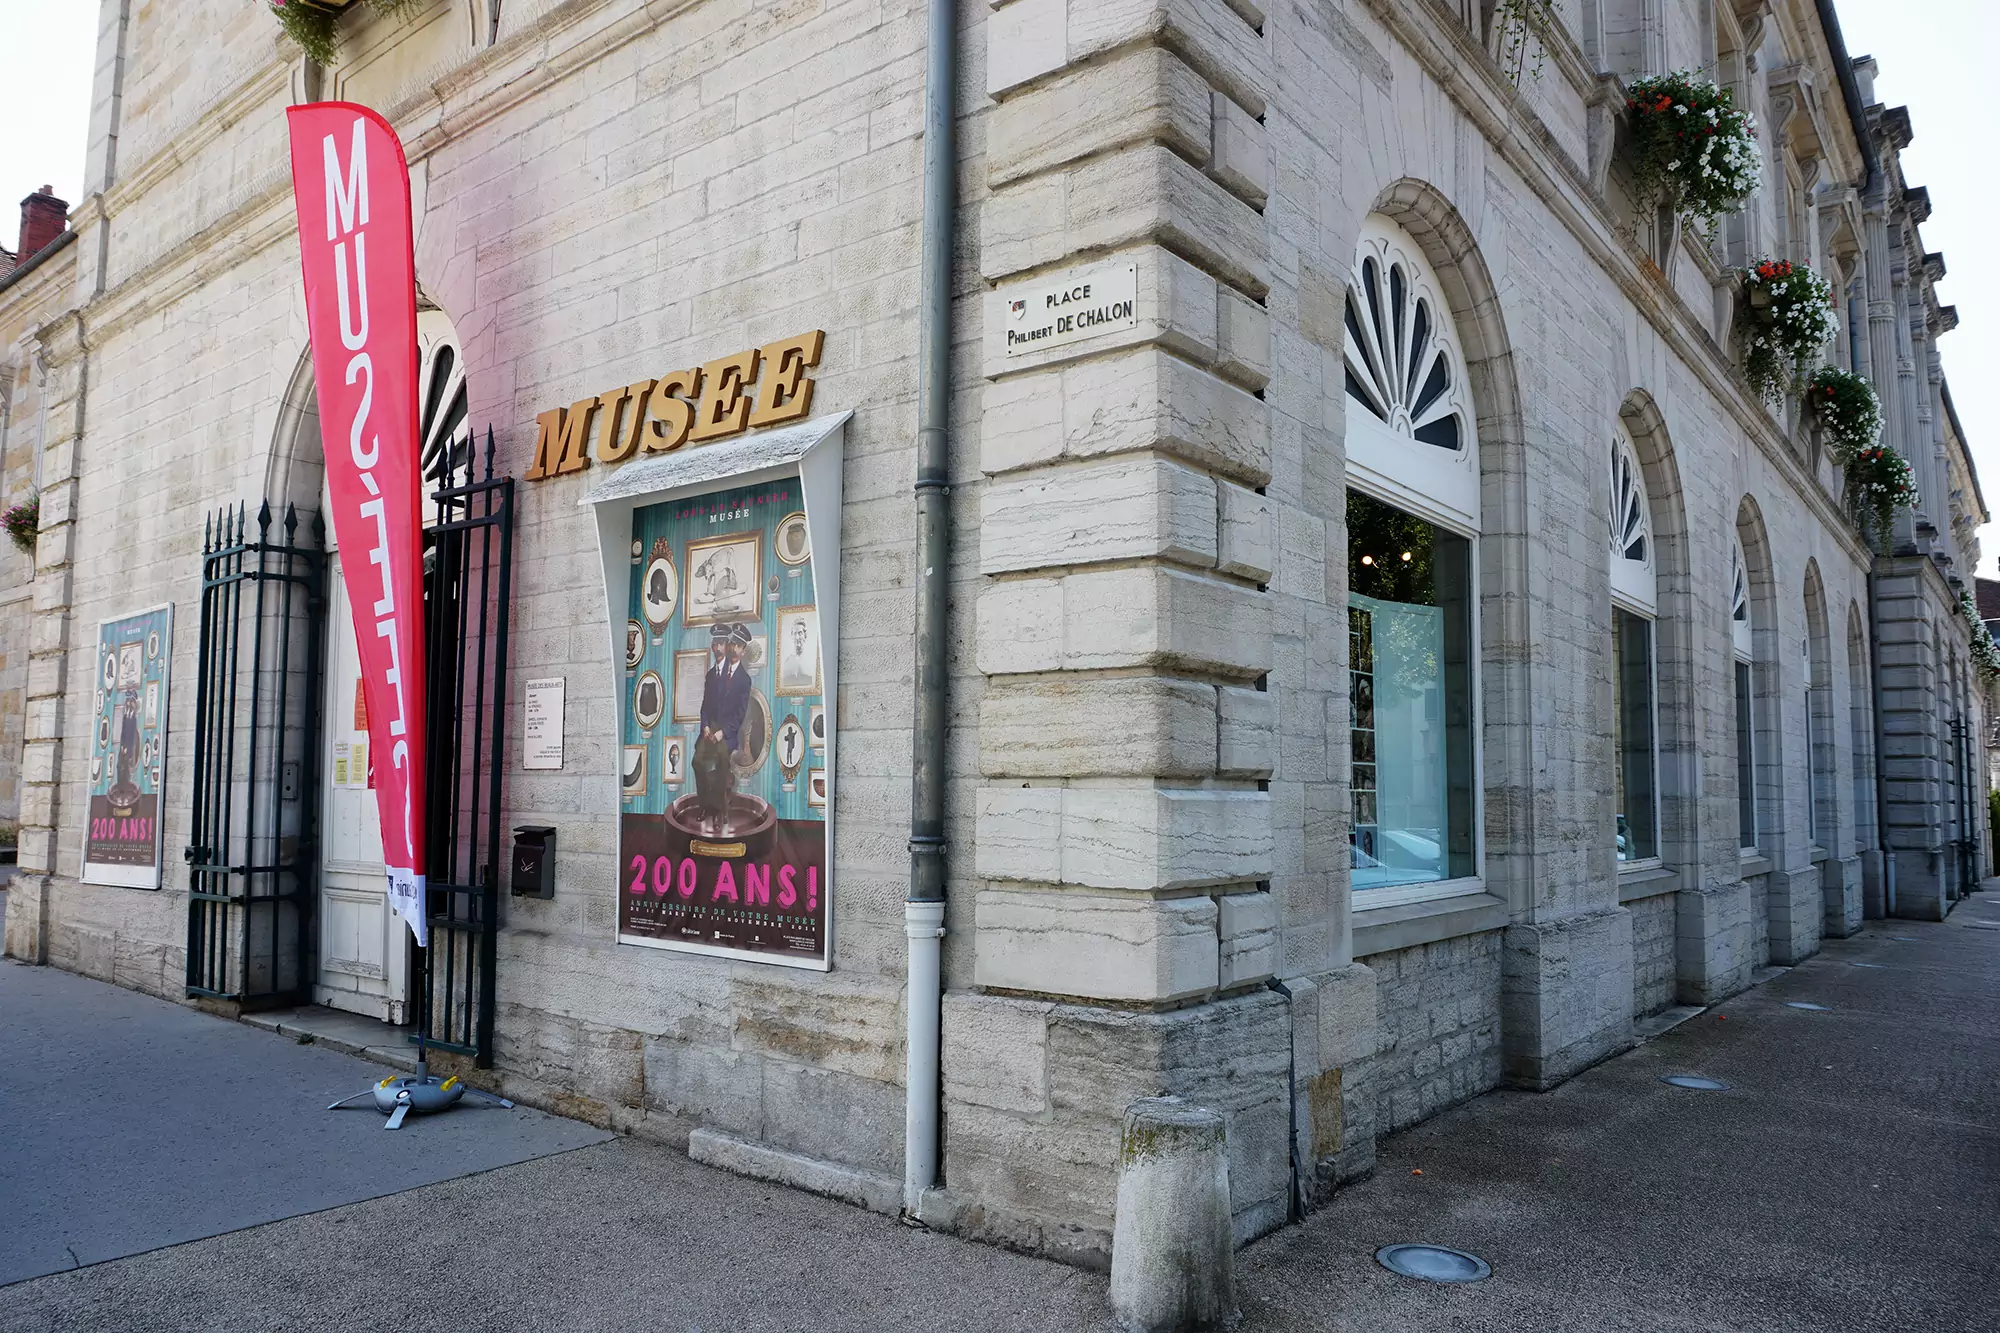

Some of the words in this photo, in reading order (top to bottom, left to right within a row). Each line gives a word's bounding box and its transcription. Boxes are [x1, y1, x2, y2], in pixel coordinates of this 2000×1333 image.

[1046, 285, 1091, 309] PLACE
[1057, 315, 1074, 334] DE
[1077, 300, 1132, 328] CHALON
[524, 329, 826, 482] MUSEE
[709, 508, 750, 523] MUSÉE
[91, 817, 116, 840] 200
[629, 855, 697, 899] 200
[630, 900, 706, 913] ANNIVERSAIRE
[733, 910, 769, 920] VOTRE
[777, 915, 816, 925] MUSÉE
[727, 917, 782, 928] NOVEMBRE
